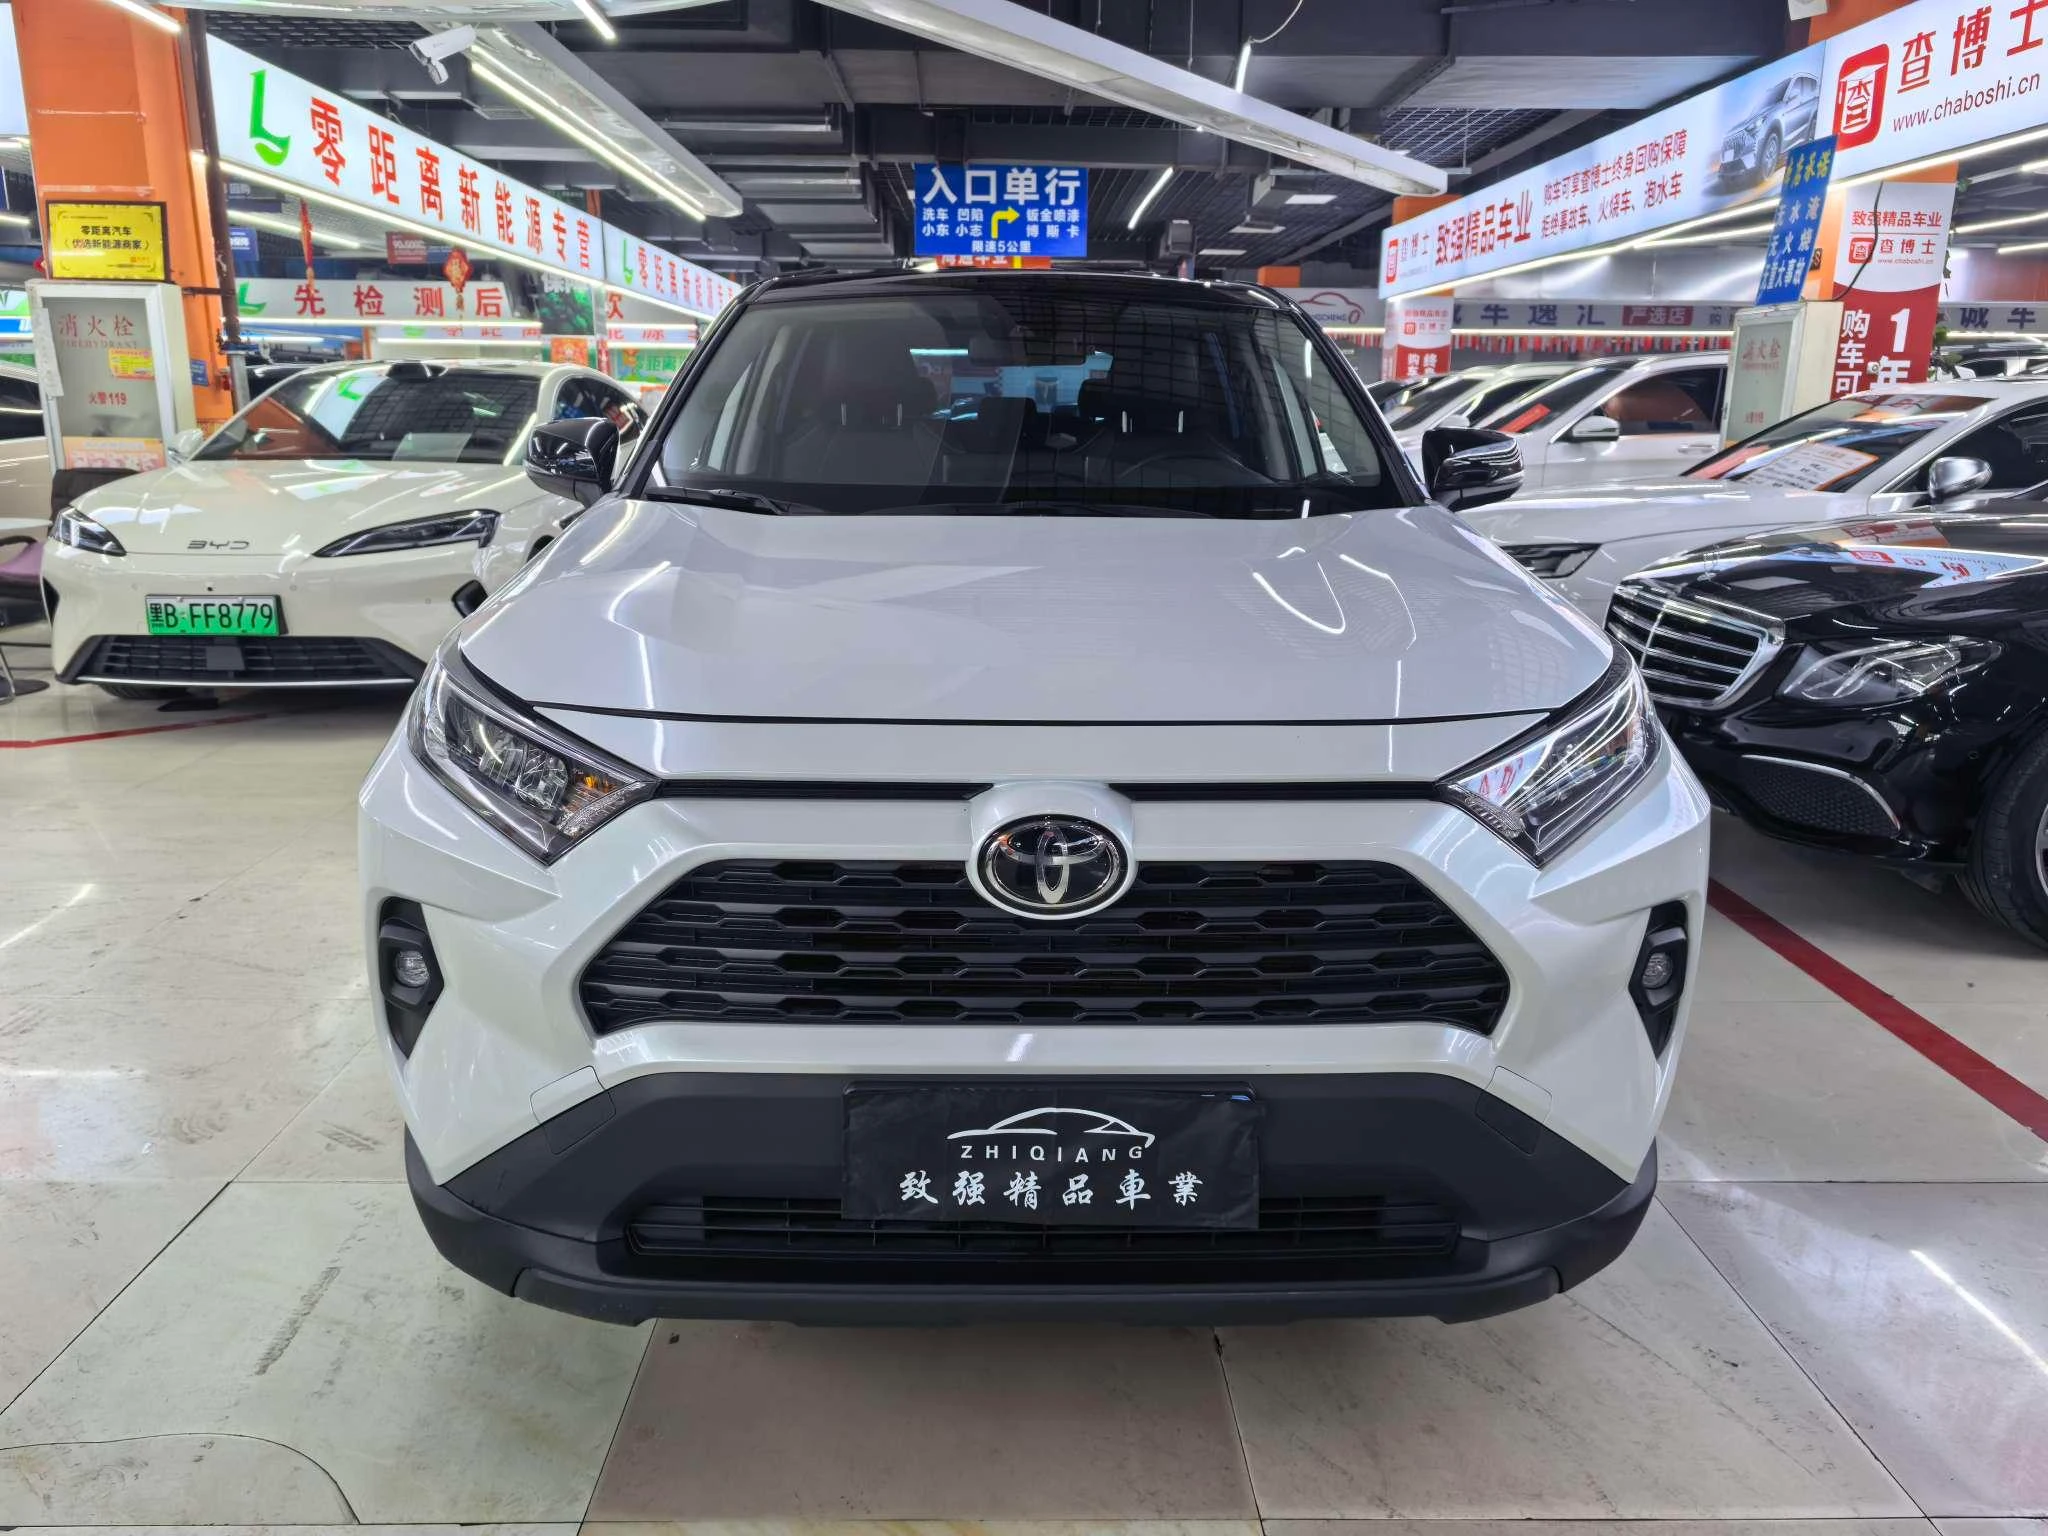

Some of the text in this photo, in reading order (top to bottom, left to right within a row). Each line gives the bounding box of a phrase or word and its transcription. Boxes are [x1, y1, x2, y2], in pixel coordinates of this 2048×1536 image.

[1897, 0, 2048, 94] 查博士
[1892, 72, 2041, 132] www.chaboshi.cn
[1543, 128, 1688, 206] 购车可享查博士终身回购保障
[310, 96, 592, 269] 零距离新能源专营
[922, 166, 1081, 206] 入口单行
[922, 207, 1080, 222] 洗车 凹陷 钣金喷漆
[1852, 210, 1942, 227] 致强精品车业
[80, 225, 132, 236] 零距离汽车
[922, 223, 949, 237] 小东
[955, 223, 983, 237] 小志
[1435, 189, 1533, 266] 致强精品车业
[971, 240, 1032, 253] 限速5公里
[1880, 239, 1936, 255] 查博士
[58, 313, 135, 338] 消火栓
[88, 391, 129, 406] 火警119
[187, 540, 250, 550] BYD
[960, 1144, 1144, 1164] ZHIQIANG
